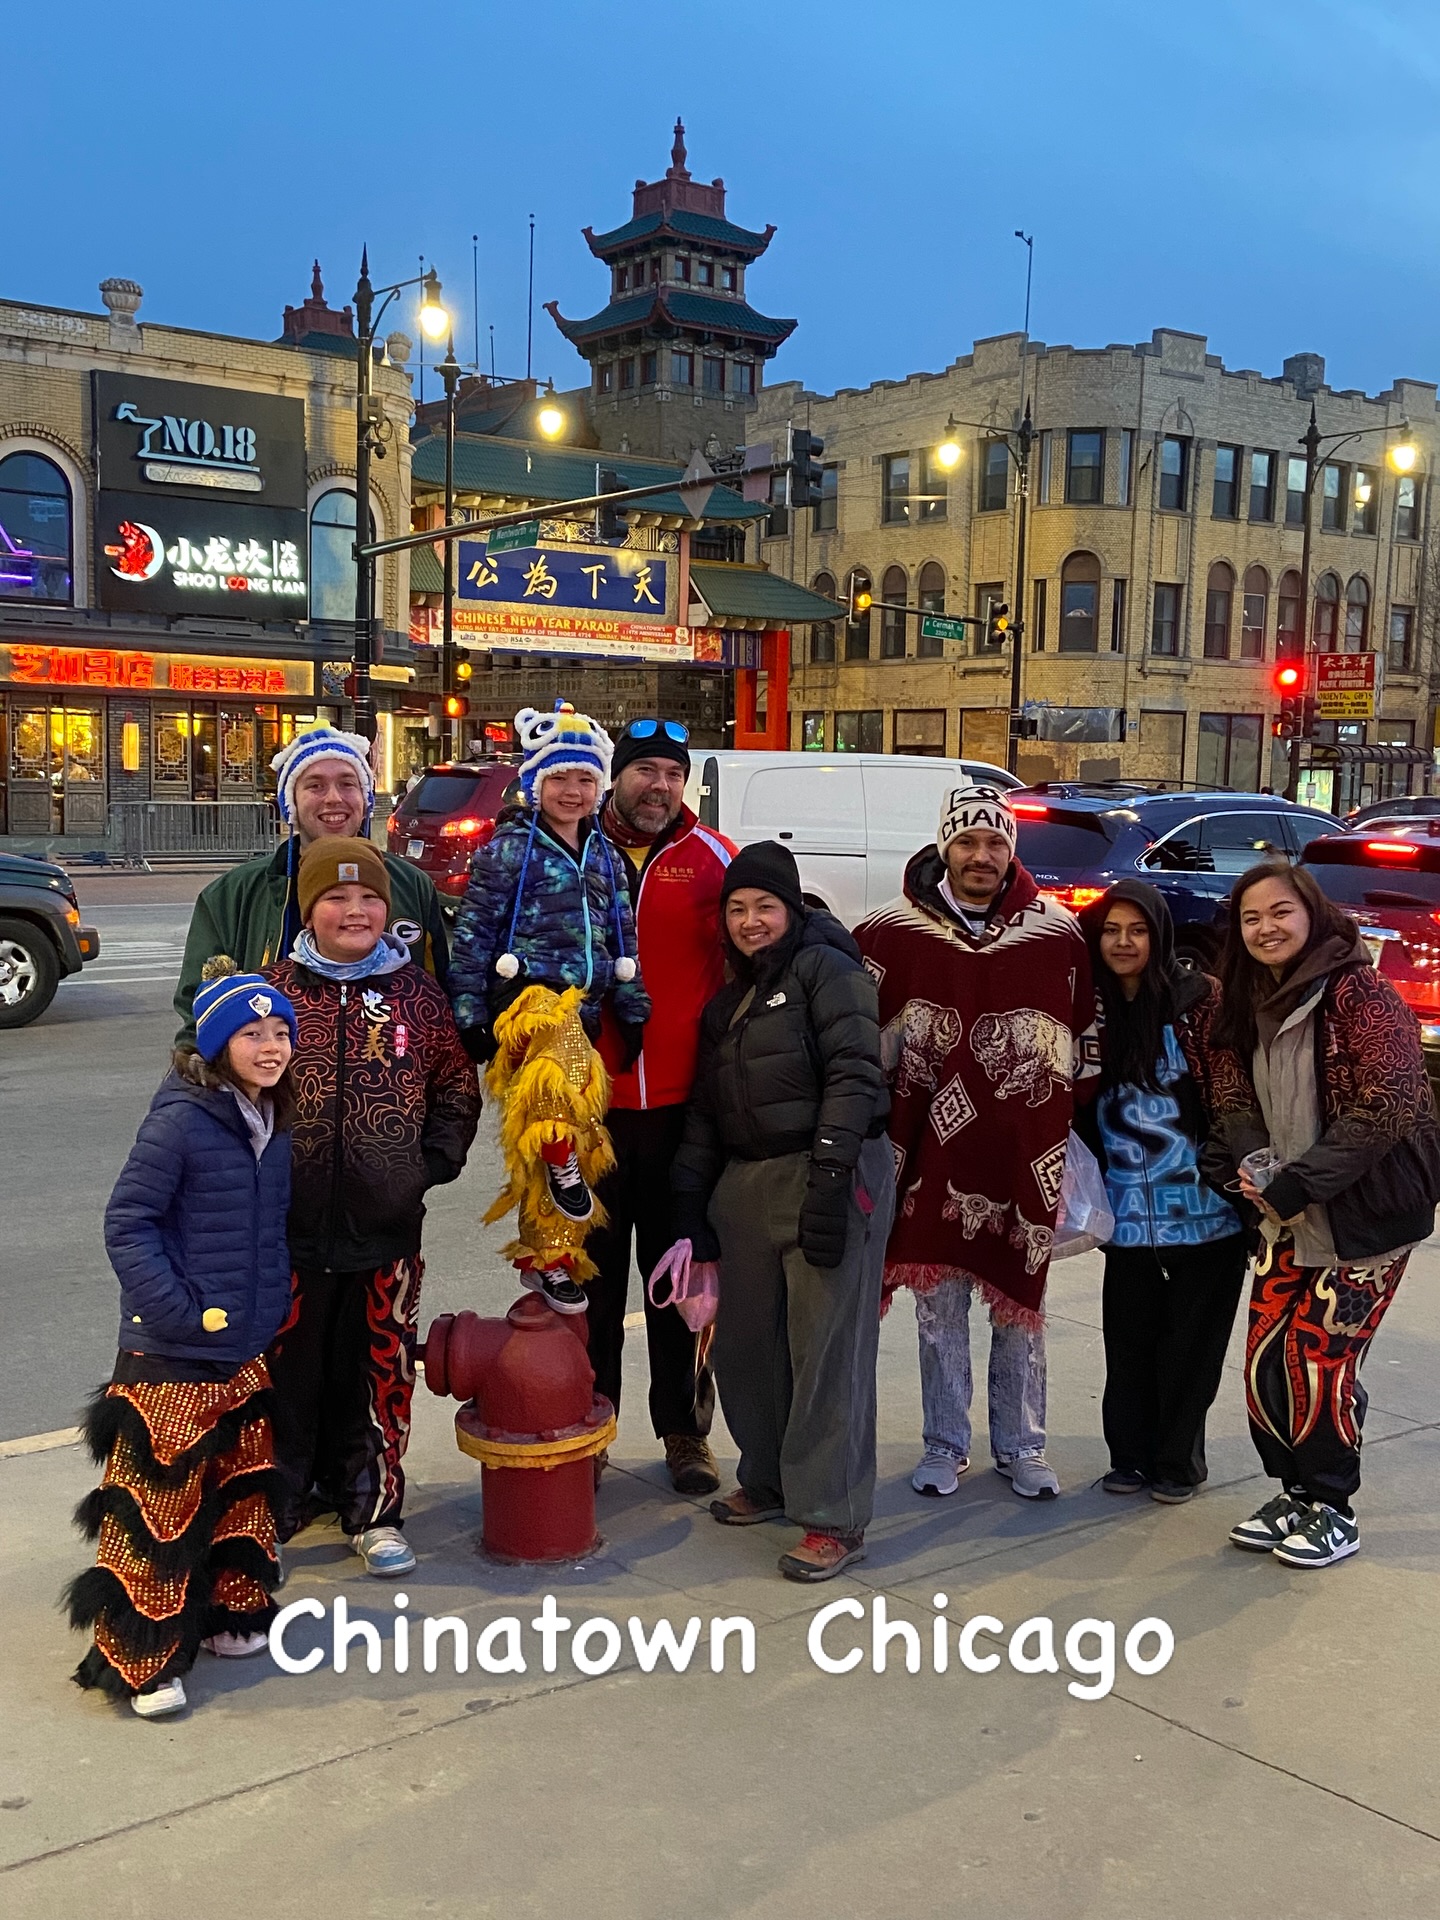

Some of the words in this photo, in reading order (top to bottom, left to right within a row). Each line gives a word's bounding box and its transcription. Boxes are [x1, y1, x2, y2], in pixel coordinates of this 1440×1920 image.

[163, 415, 257, 462] NO.18
[496, 526, 527, 540] Wentworth
[173, 571, 217, 588] SHOO
[272, 579, 305, 595] KAN
[455, 612, 507, 625] CHINESE
[510, 616, 538, 627] NEW
[541, 617, 572, 631] YEAR
[575, 620, 620, 634] PARADE
[932, 621, 954, 630] Cermak
[10, 645, 154, 688] 芝加哥店
[1323, 656, 1371, 669] 太平洋
[169, 663, 286, 693] 服务至凌晨
[1319, 680, 1338, 688] PACIFIC
[1338, 679, 1365, 688] FURNITURE
[1317, 692, 1351, 700] ORIENTAL
[1354, 692, 1373, 700] GIFTS
